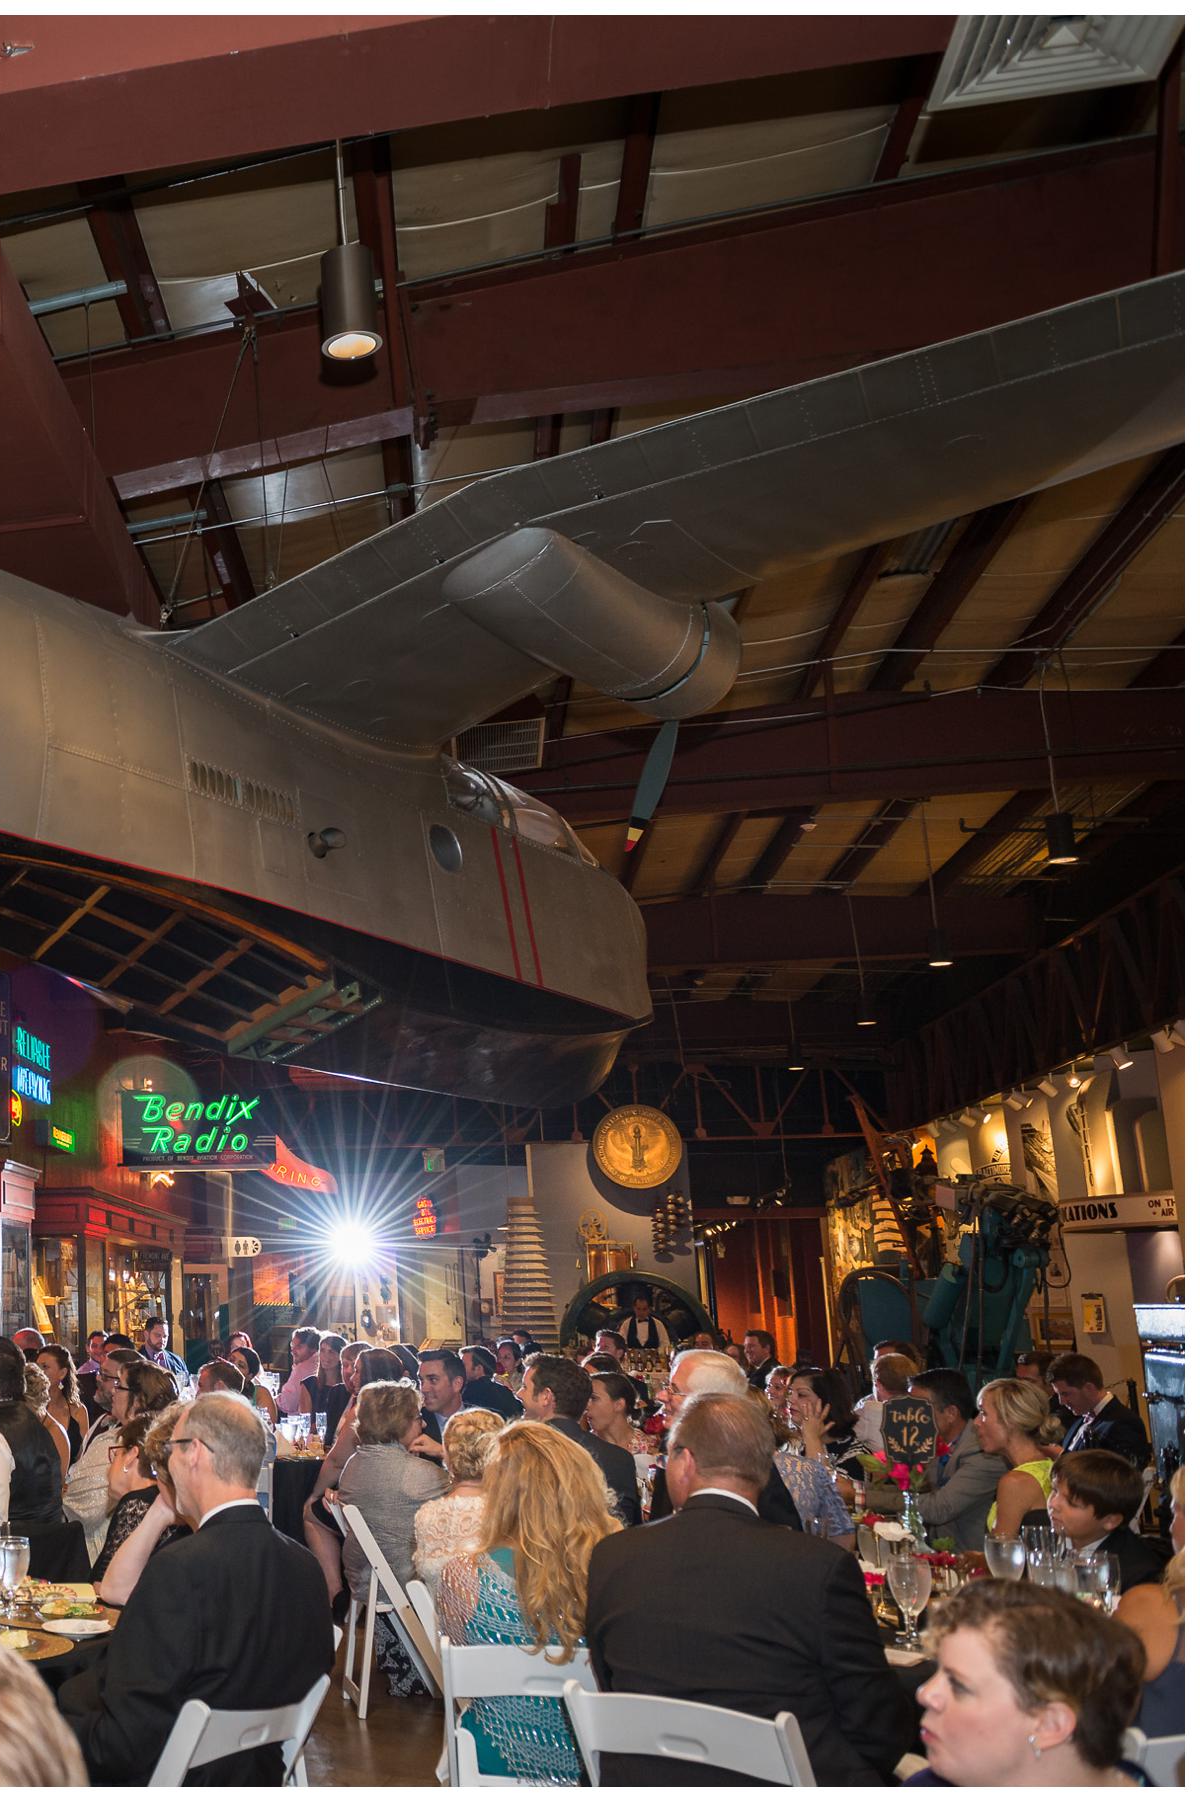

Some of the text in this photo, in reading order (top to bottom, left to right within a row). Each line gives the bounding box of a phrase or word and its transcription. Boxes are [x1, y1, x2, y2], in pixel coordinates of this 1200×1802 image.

[132, 1094, 261, 1126] Bendix
[141, 1126, 249, 1153] Radio
[1148, 1199, 1161, 1208] ON
[1161, 1208, 1175, 1217] AIR
[889, 1407, 930, 1424] table
[901, 1425, 920, 1446] 12
